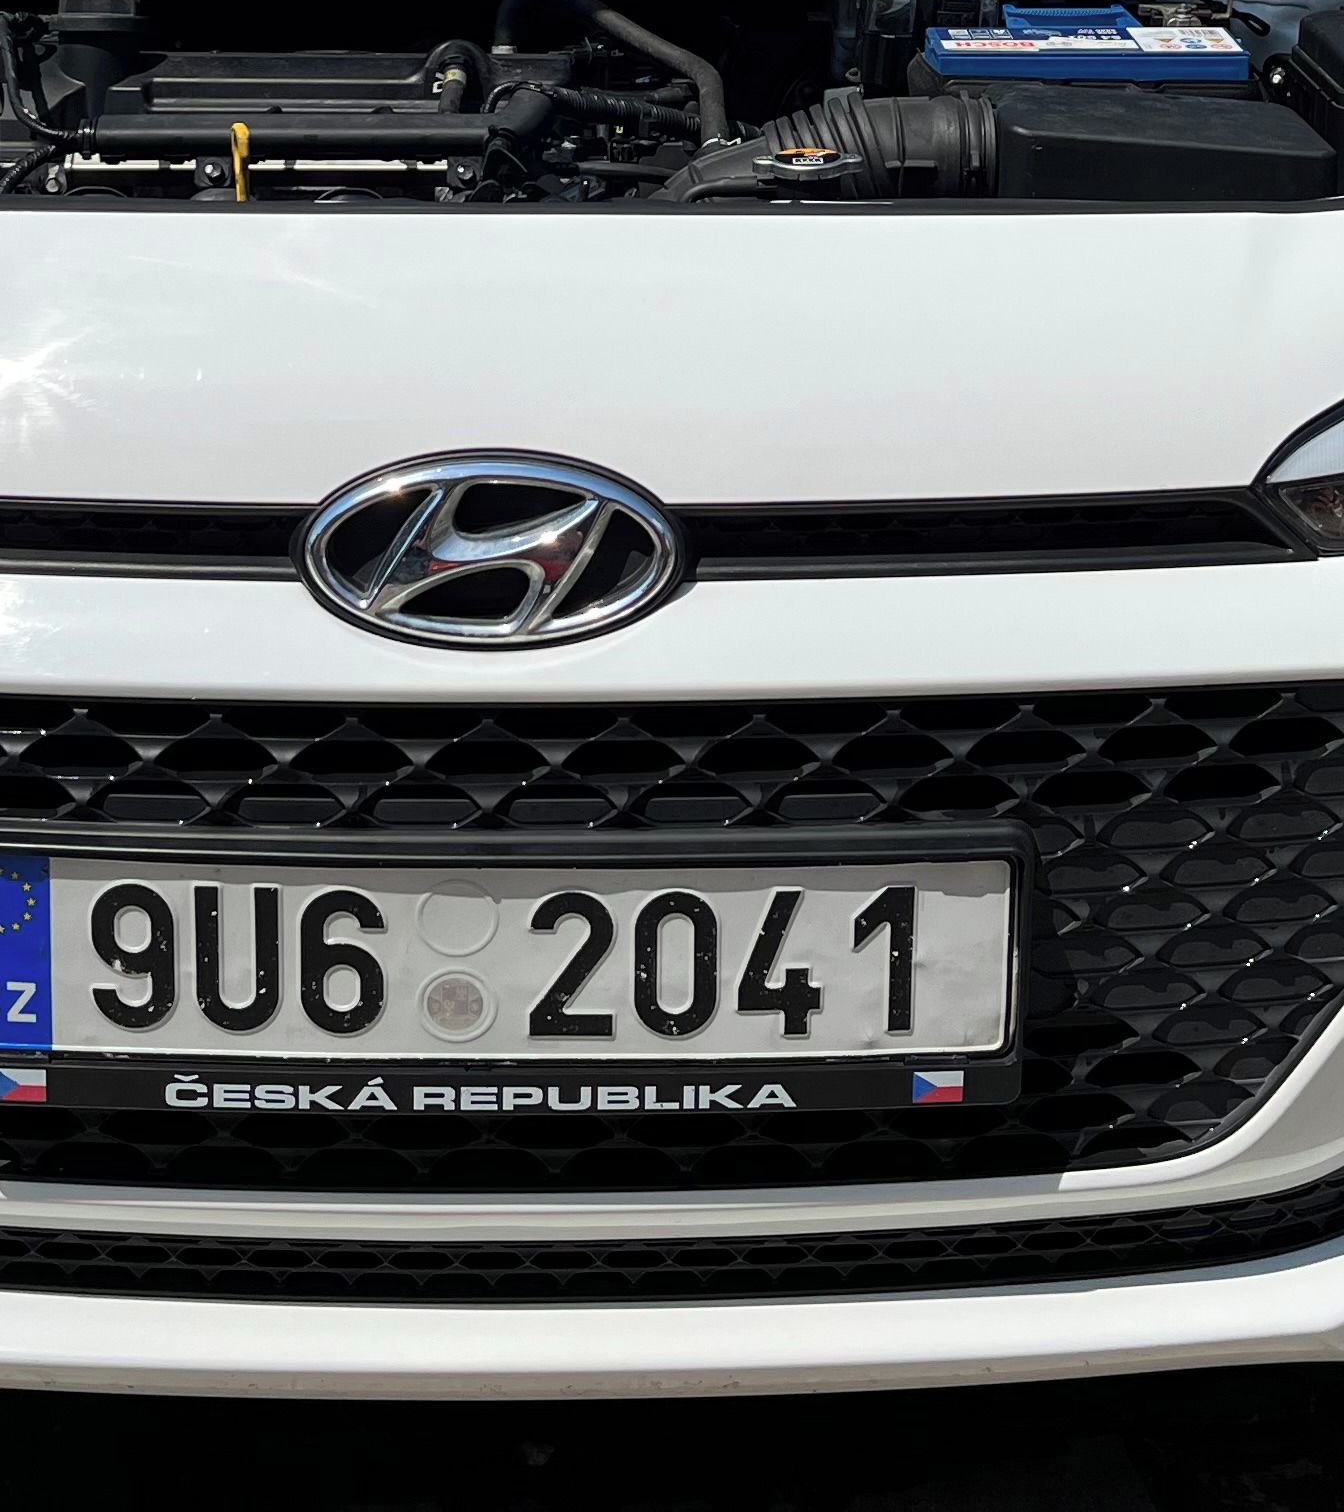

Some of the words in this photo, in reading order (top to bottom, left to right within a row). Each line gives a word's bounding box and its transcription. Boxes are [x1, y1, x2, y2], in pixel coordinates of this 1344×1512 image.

[955, 40, 1035, 48] BOSCH
[90, 882, 386, 1035] 9U6
[528, 885, 916, 1039] 2041
[164, 1074, 398, 1111] ČESKÁ
[412, 1084, 797, 1111] REPUBLIKA
